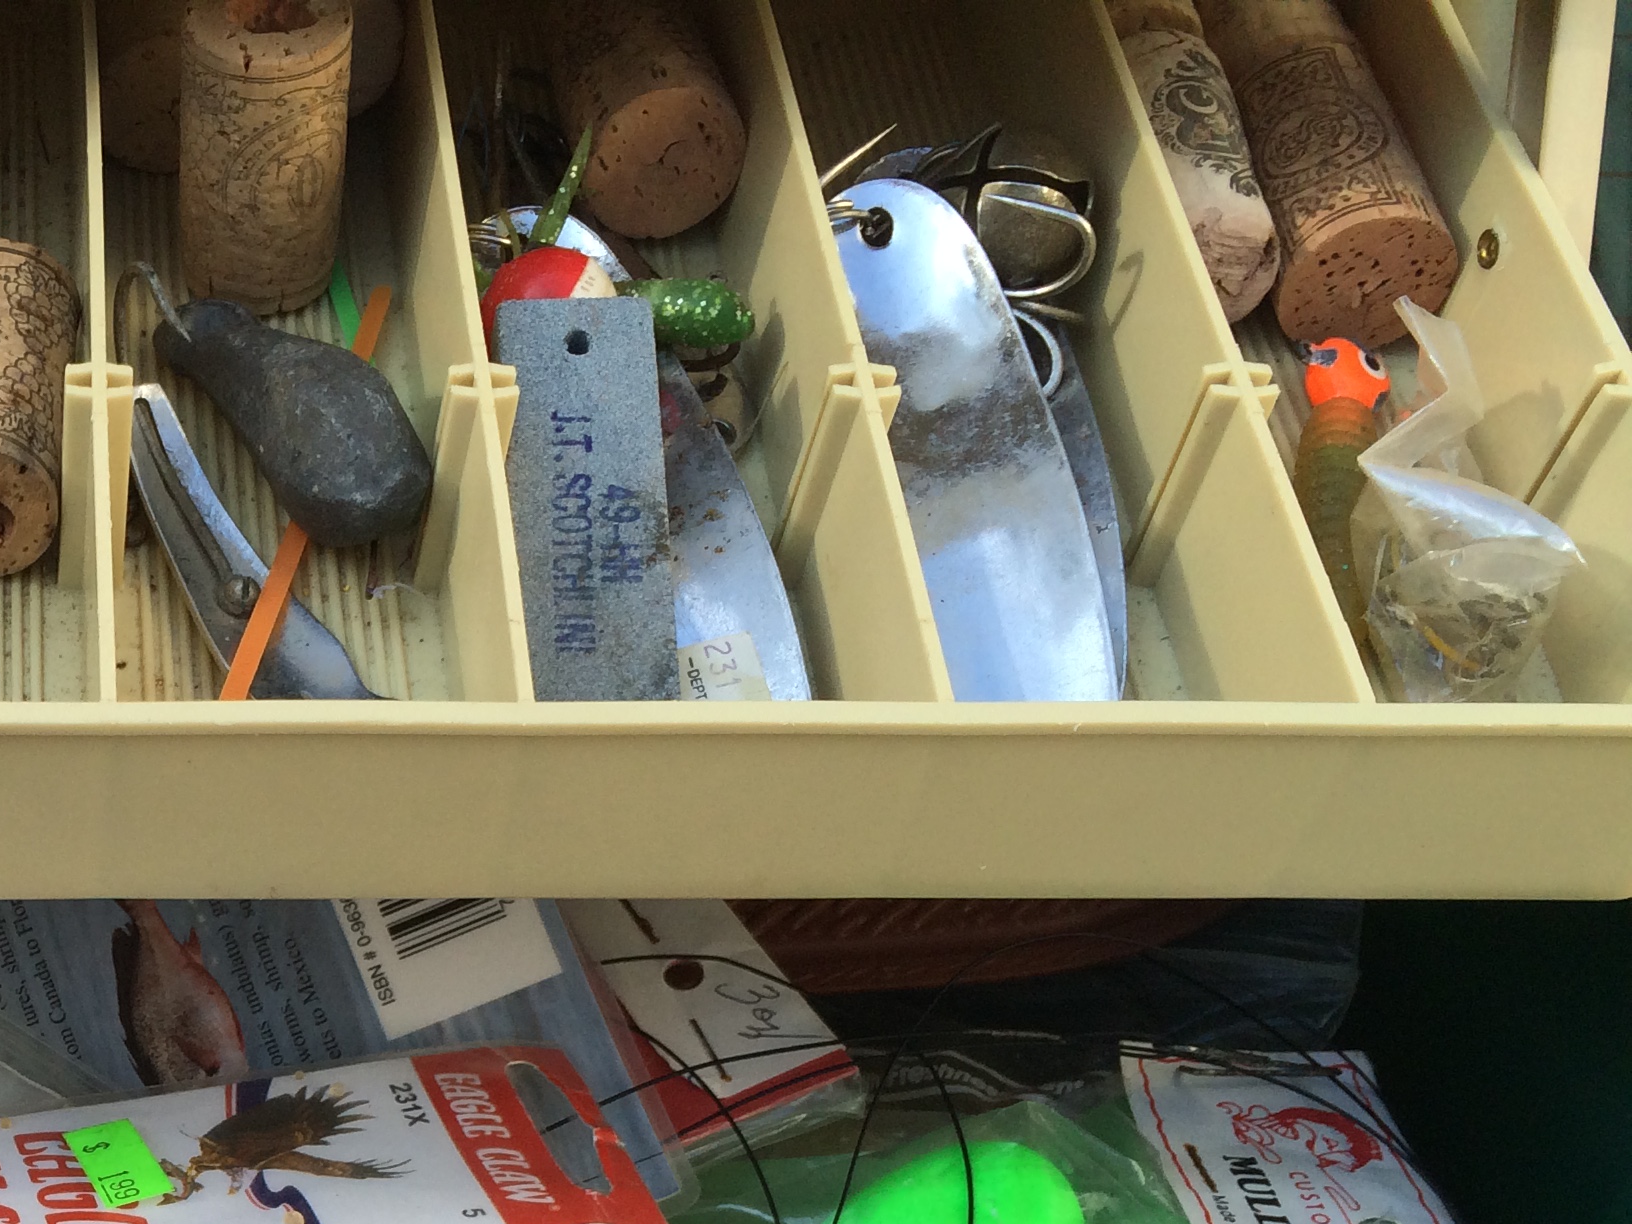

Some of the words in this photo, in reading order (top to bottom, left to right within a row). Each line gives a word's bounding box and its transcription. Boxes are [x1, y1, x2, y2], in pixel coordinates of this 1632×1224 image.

[35, 958, 71, 1024] Canada
[366, 962, 397, 1007] ISBN
[389, 1081, 430, 1127] 231X
[433, 1071, 496, 1140] EAGLE
[476, 1144, 556, 1207] CLAW
[461, 1207, 487, 1220] 5
[1212, 1194, 1237, 1224] Made
